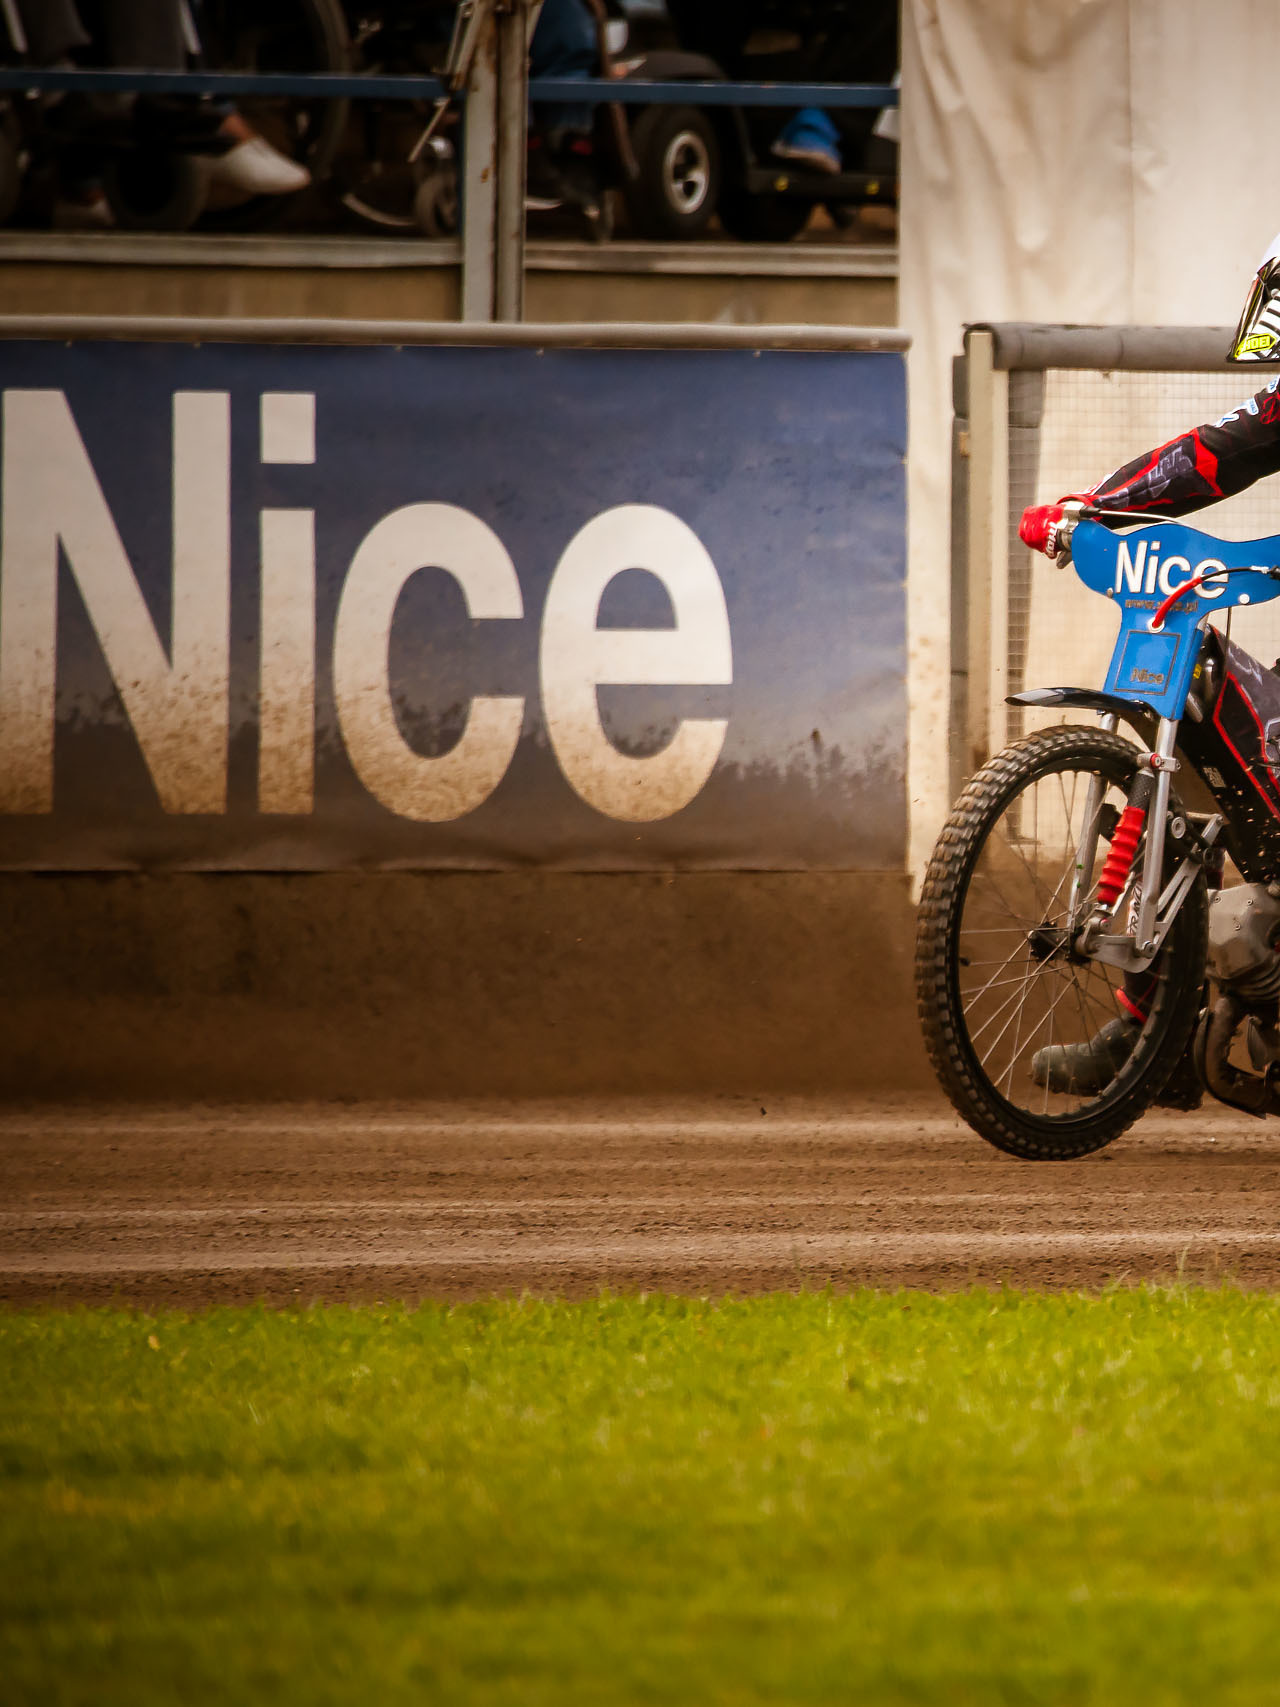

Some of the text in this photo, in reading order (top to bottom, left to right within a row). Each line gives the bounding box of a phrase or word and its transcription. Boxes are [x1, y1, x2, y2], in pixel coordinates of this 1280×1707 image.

[1115, 540, 1228, 599] Nice
[0, 389, 733, 823] Nice
[1131, 667, 1164, 685] Nice
